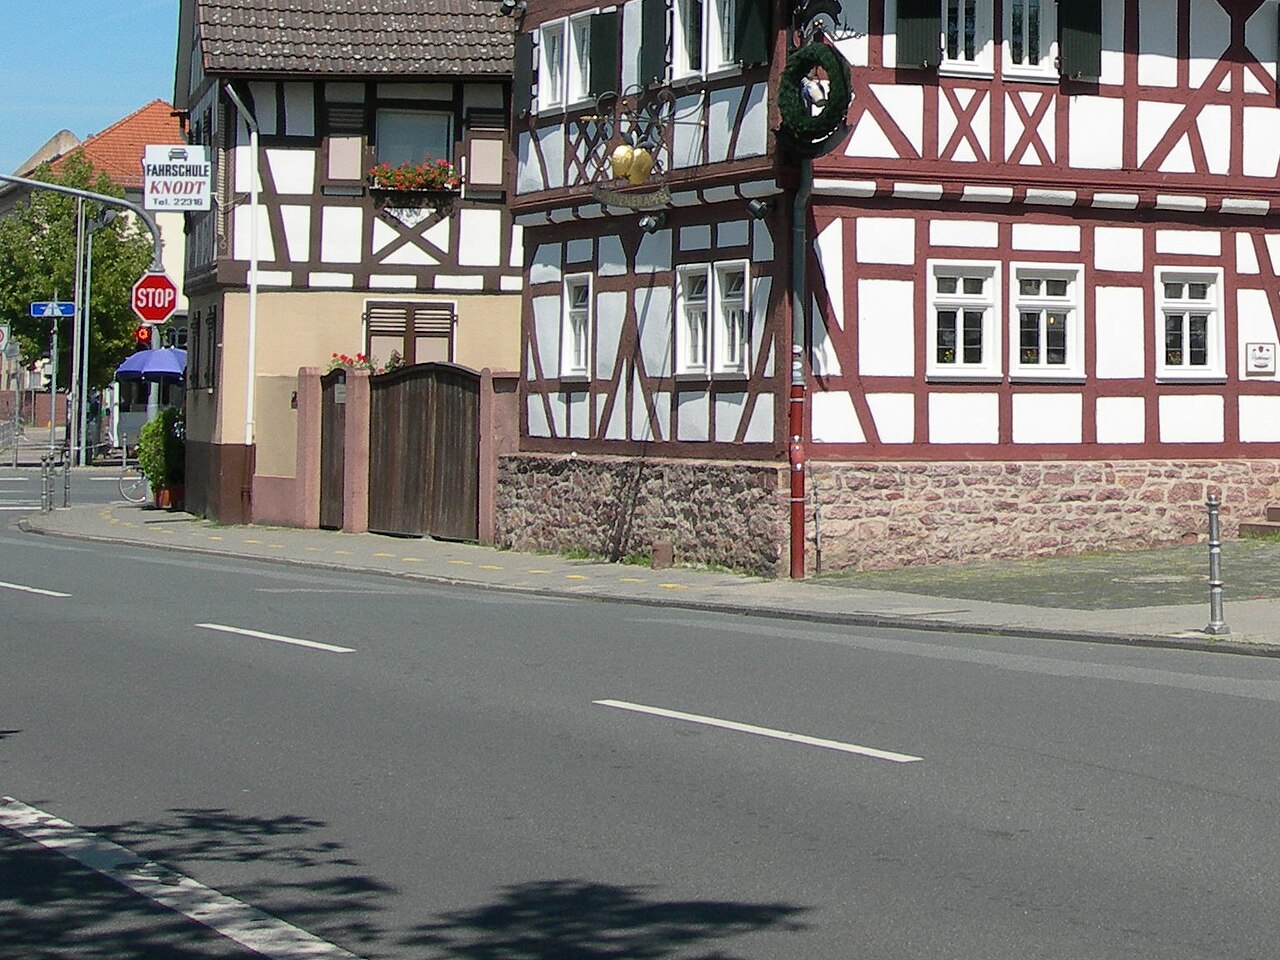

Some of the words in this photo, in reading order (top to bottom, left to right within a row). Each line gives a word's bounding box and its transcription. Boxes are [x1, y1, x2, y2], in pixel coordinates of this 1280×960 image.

[147, 164, 209, 177] FAHRSCHULE
[150, 180, 206, 195] KNODT
[153, 198, 170, 206] Tel.
[137, 288, 174, 308] STOP
